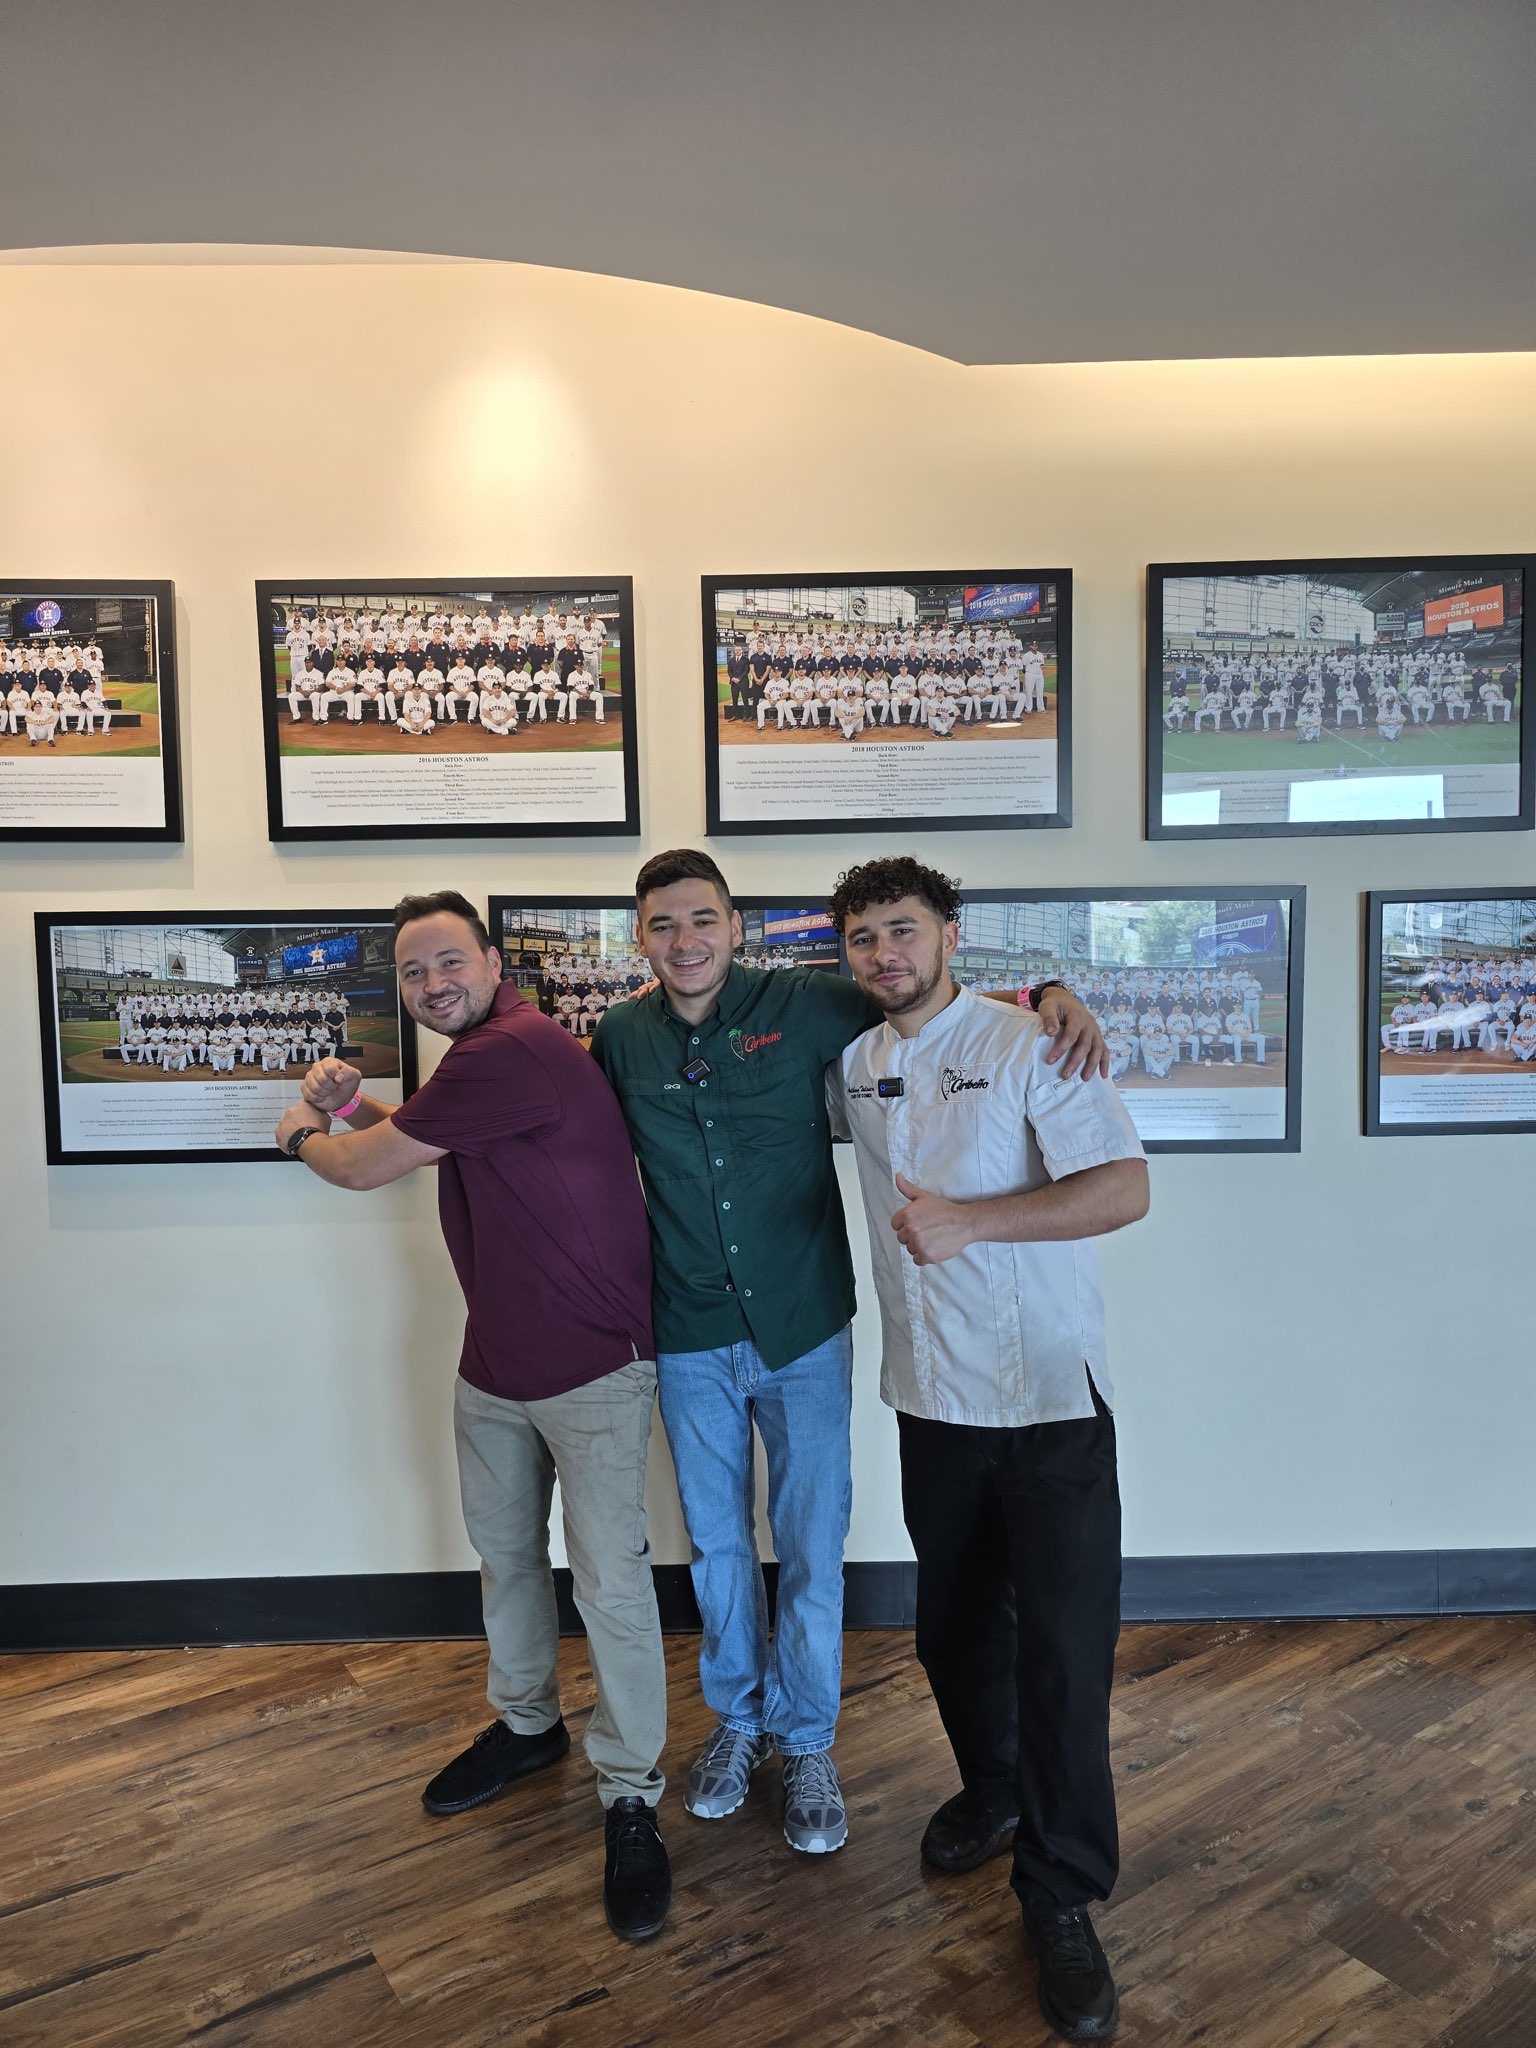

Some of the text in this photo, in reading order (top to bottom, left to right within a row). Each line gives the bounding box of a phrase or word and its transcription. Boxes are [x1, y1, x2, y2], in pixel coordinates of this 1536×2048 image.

[1438, 578, 1483, 595] Minute Maid
[983, 598, 1008, 609] HOUSTON
[1009, 592, 1033, 603] ASTROS
[1450, 602, 1470, 611] 2020
[1427, 602, 1500, 622] HOUSTON ASTROS
[1213, 921, 1239, 933] HOUSTON
[1240, 917, 1264, 928] ASTROS
[296, 927, 339, 942] Minute Maid
[304, 965, 325, 973] HOUSTON
[326, 962, 347, 970] ASTROS
